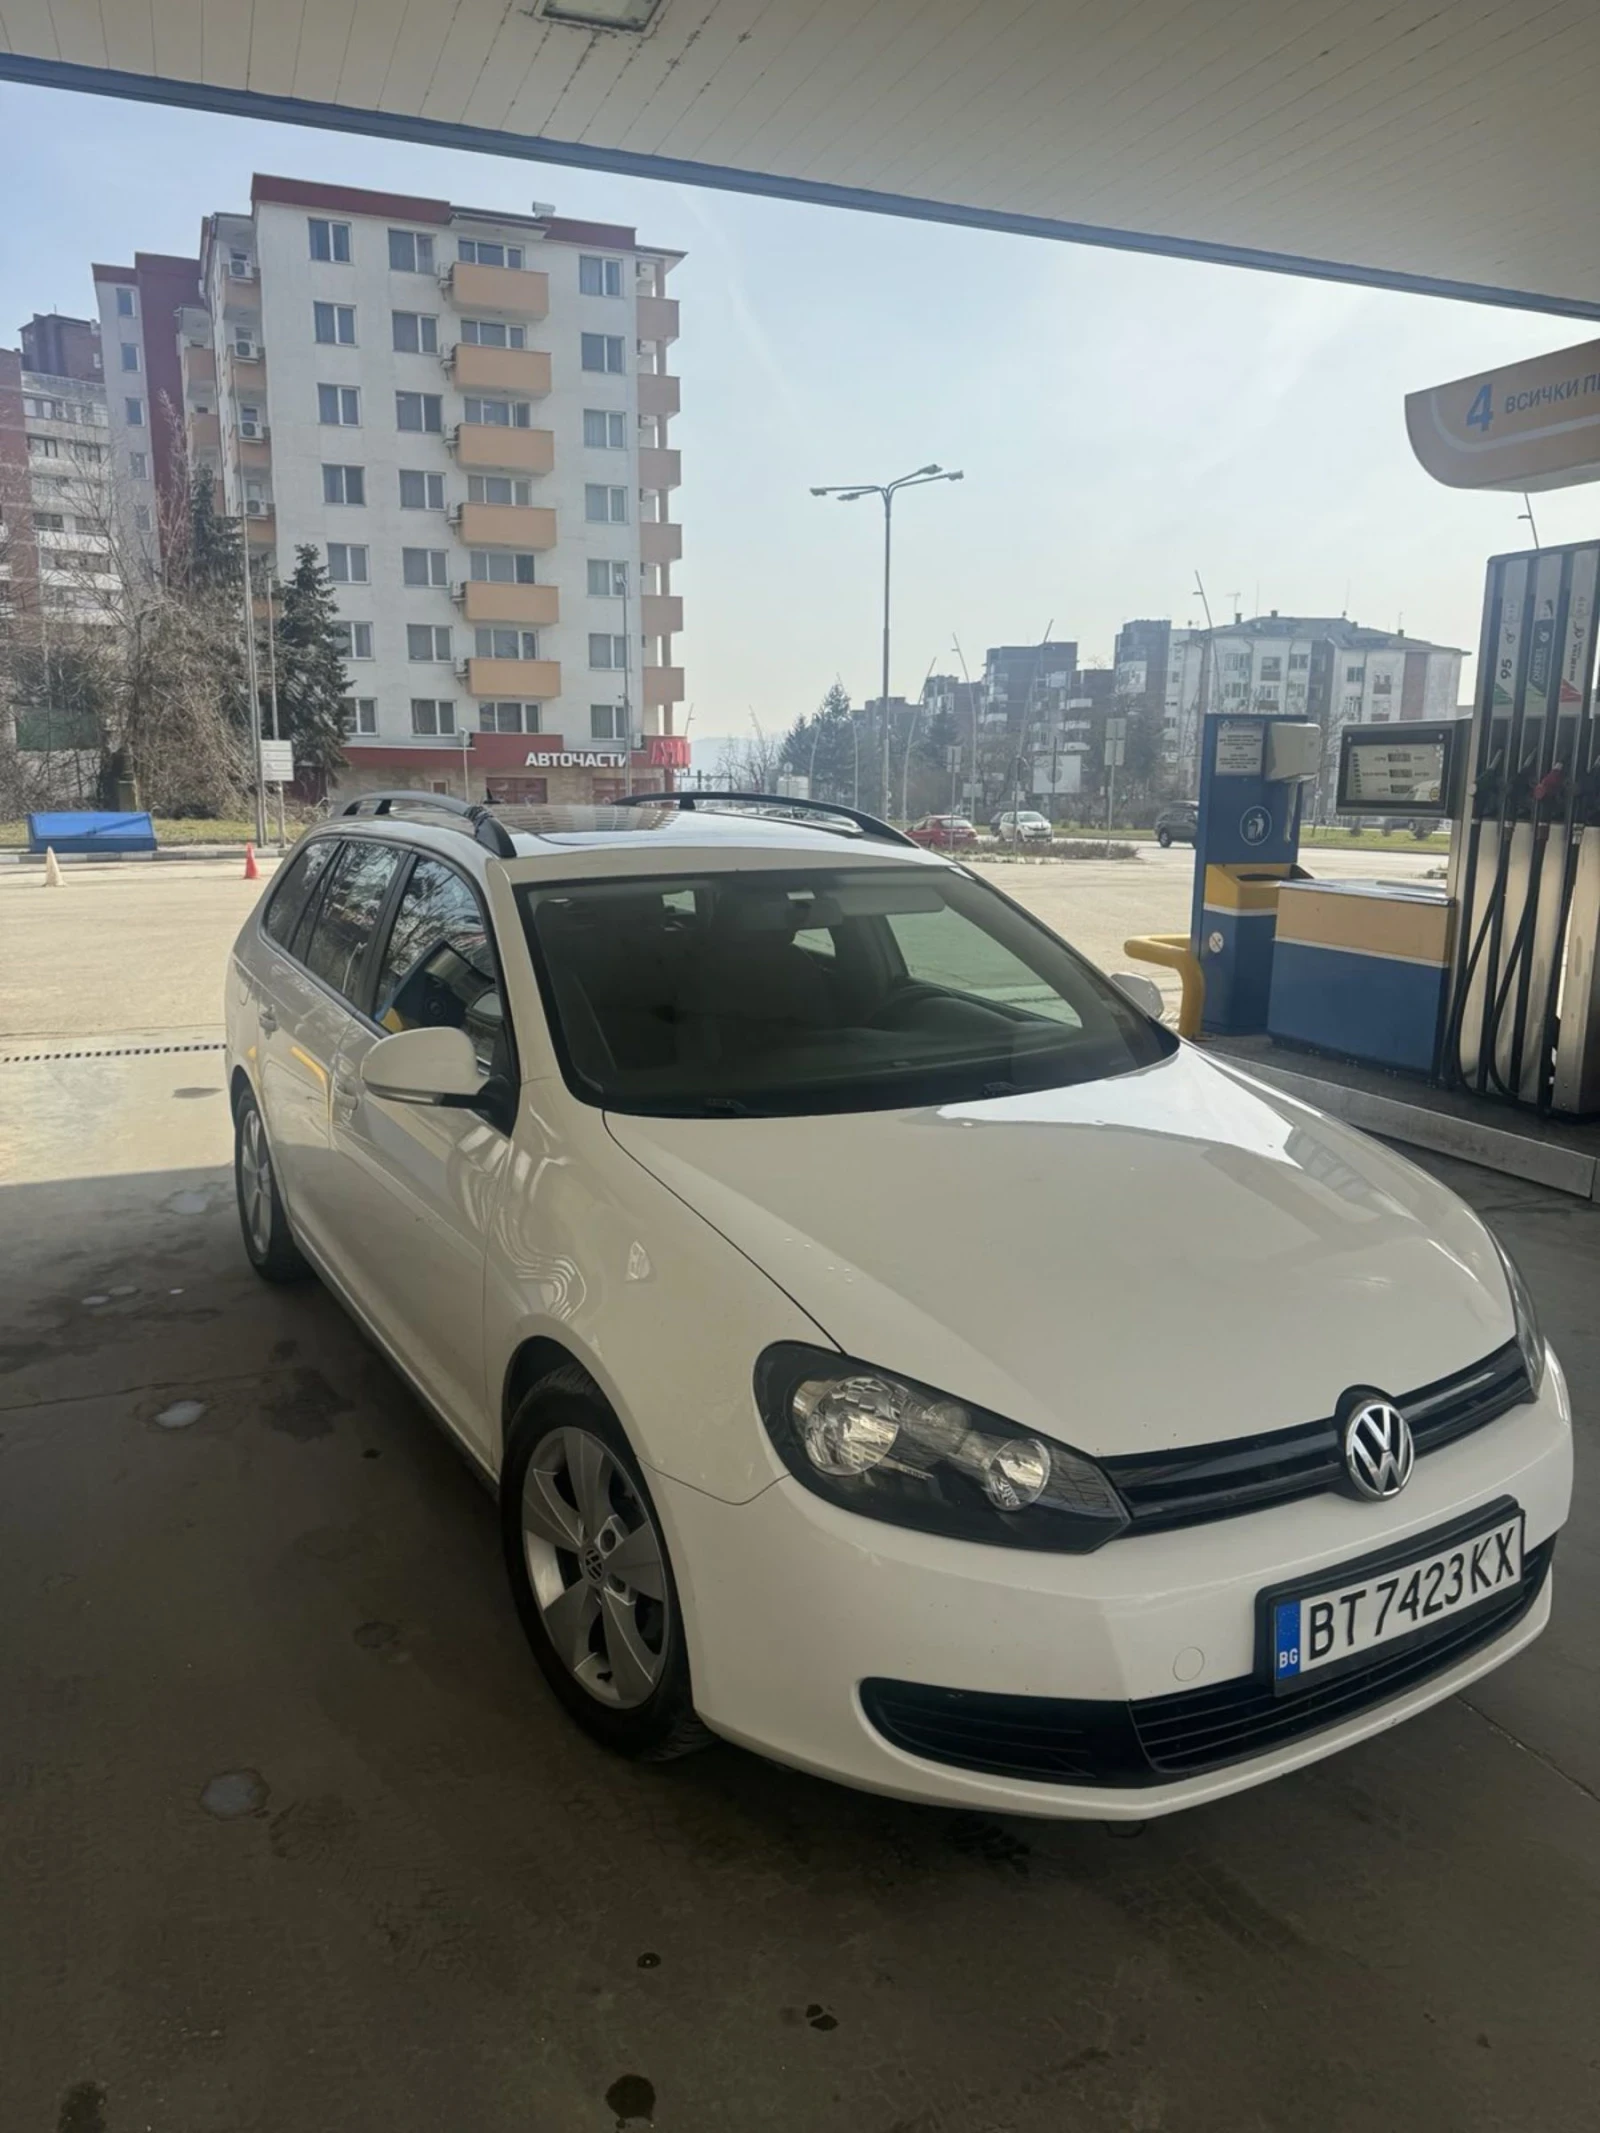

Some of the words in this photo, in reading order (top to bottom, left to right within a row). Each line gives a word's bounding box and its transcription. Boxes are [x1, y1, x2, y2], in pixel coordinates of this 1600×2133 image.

[1466, 383, 1494, 432] 4
[1505, 377, 1579, 414] ВСИЧКИ
[1584, 372, 1600, 394] П
[1500, 659, 1513, 679] 95
[1278, 1647, 1299, 1669] BG
